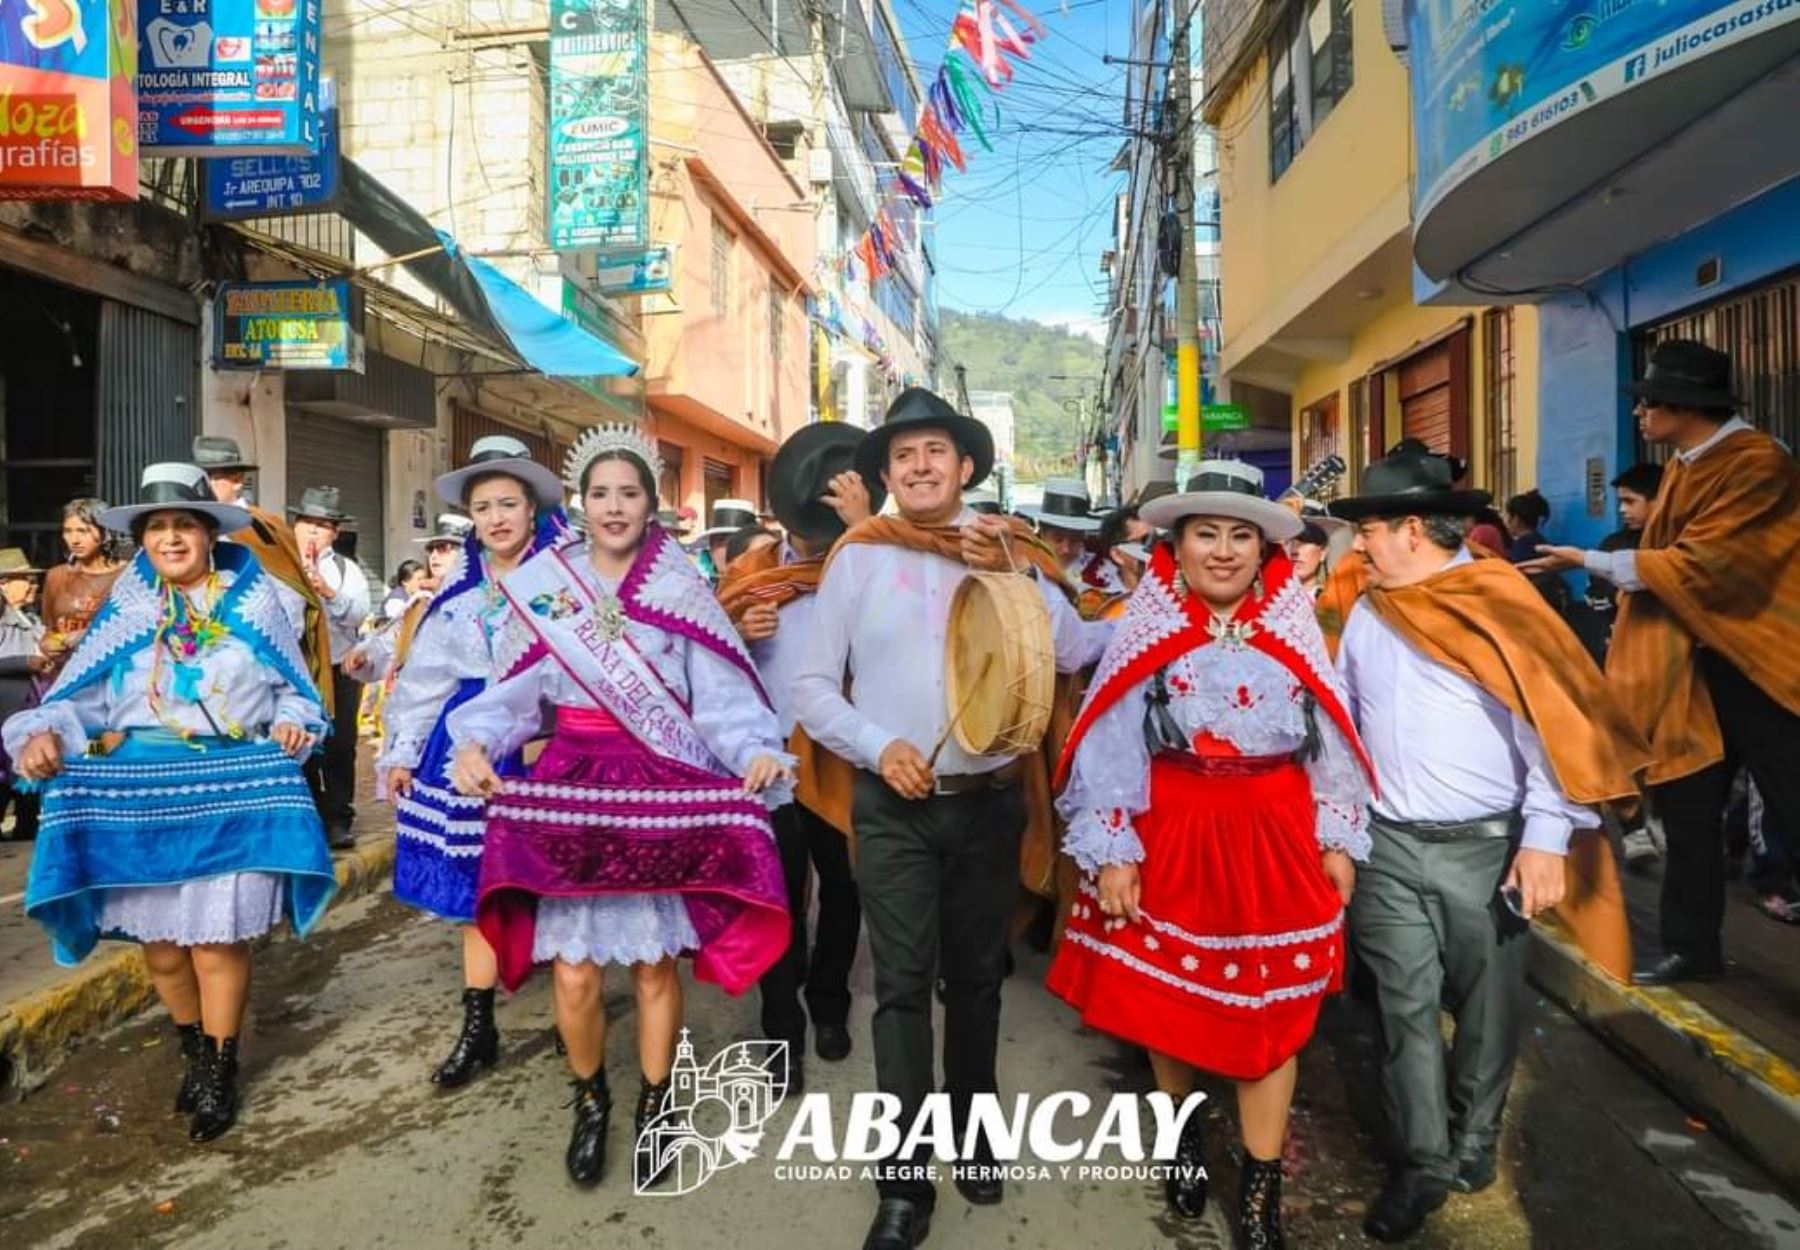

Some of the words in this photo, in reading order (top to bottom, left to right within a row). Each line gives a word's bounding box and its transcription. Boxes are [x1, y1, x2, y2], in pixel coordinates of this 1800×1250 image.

[192, 71, 250, 86] INTEGRAL
[231, 155, 312, 178] SELLOS
[239, 175, 295, 194] AREQUIPA
[266, 193, 286, 209] INT
[574, 618, 622, 676] REINA
[617, 668, 656, 705] DEL
